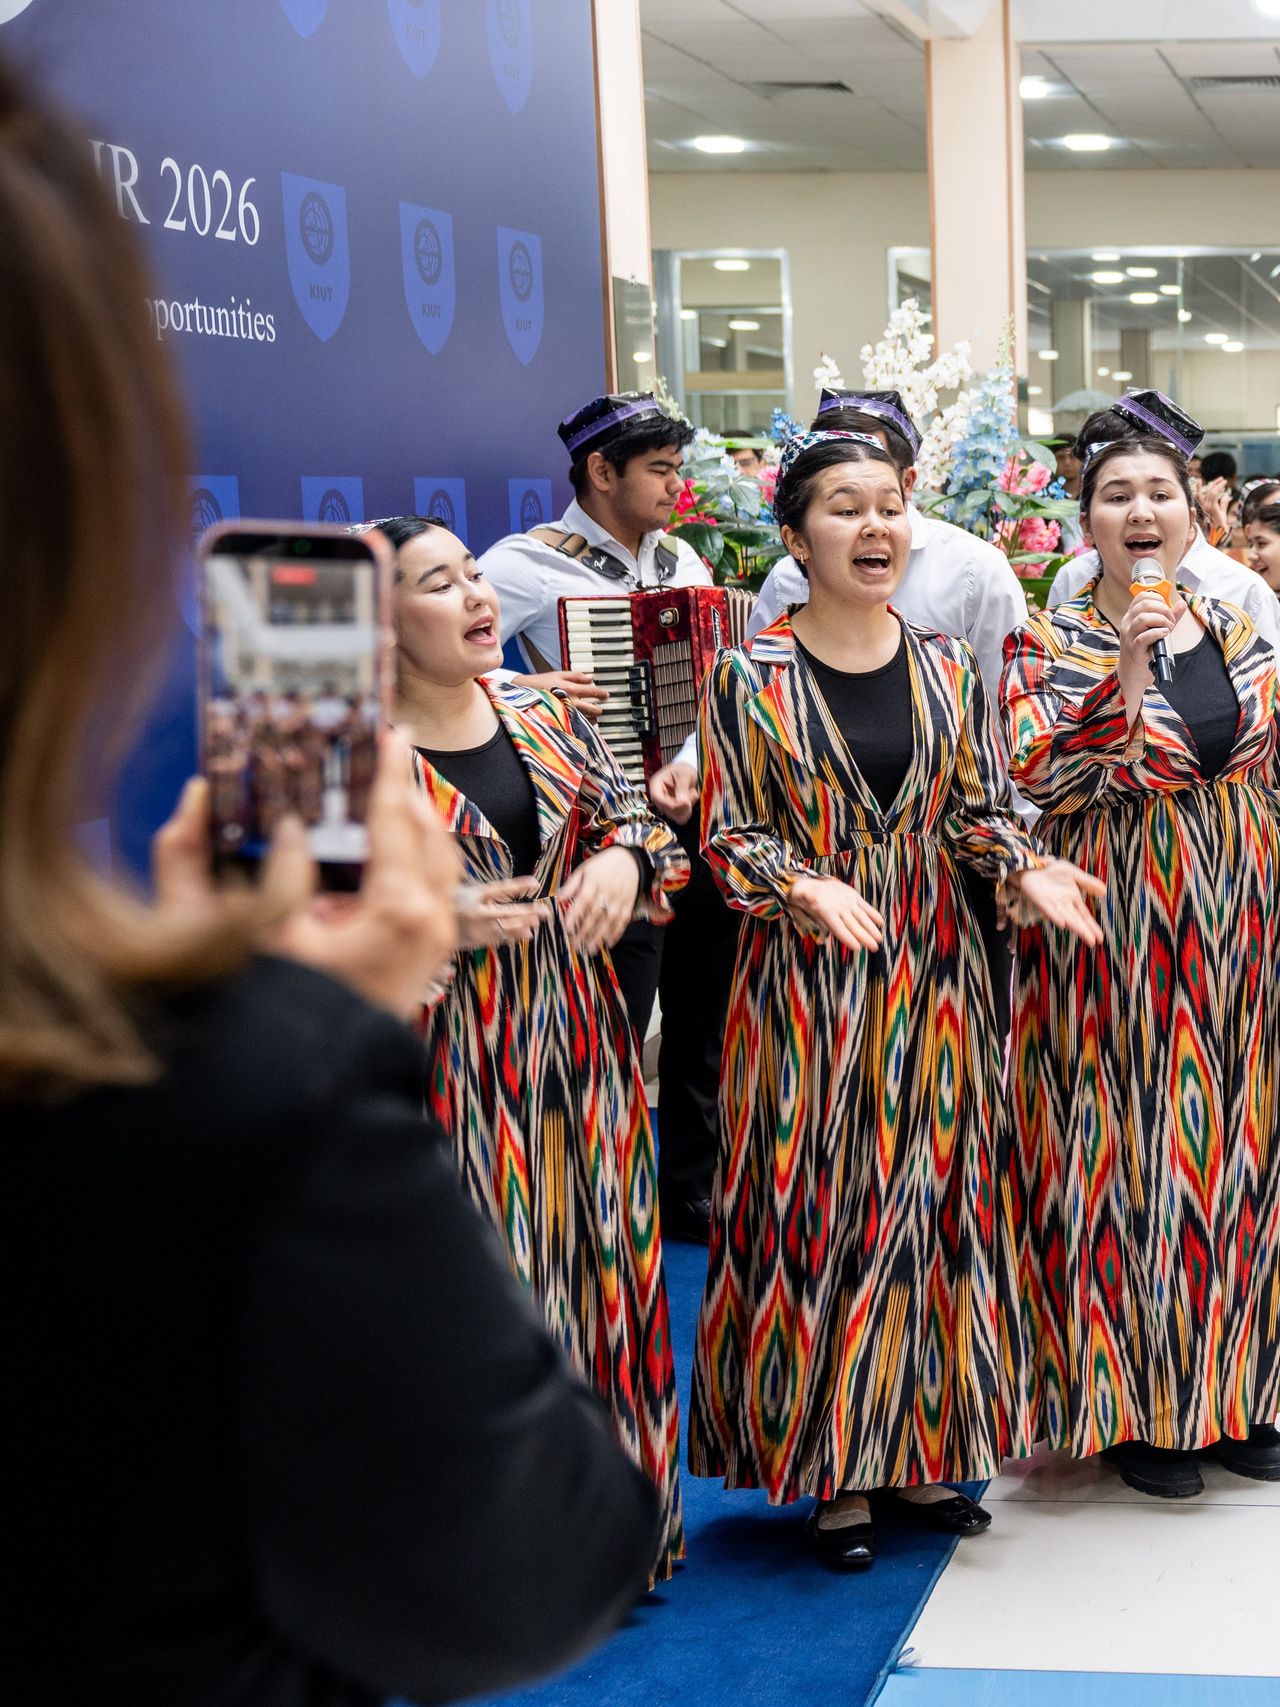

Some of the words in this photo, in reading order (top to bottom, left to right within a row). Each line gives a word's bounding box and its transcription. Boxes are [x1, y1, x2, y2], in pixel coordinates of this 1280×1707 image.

[406, 24, 425, 43] KIUT
[160, 157, 260, 246] 2026
[309, 284, 333, 301] KIUT
[421, 302, 441, 318] KIUT
[515, 318, 532, 332] KIUT
